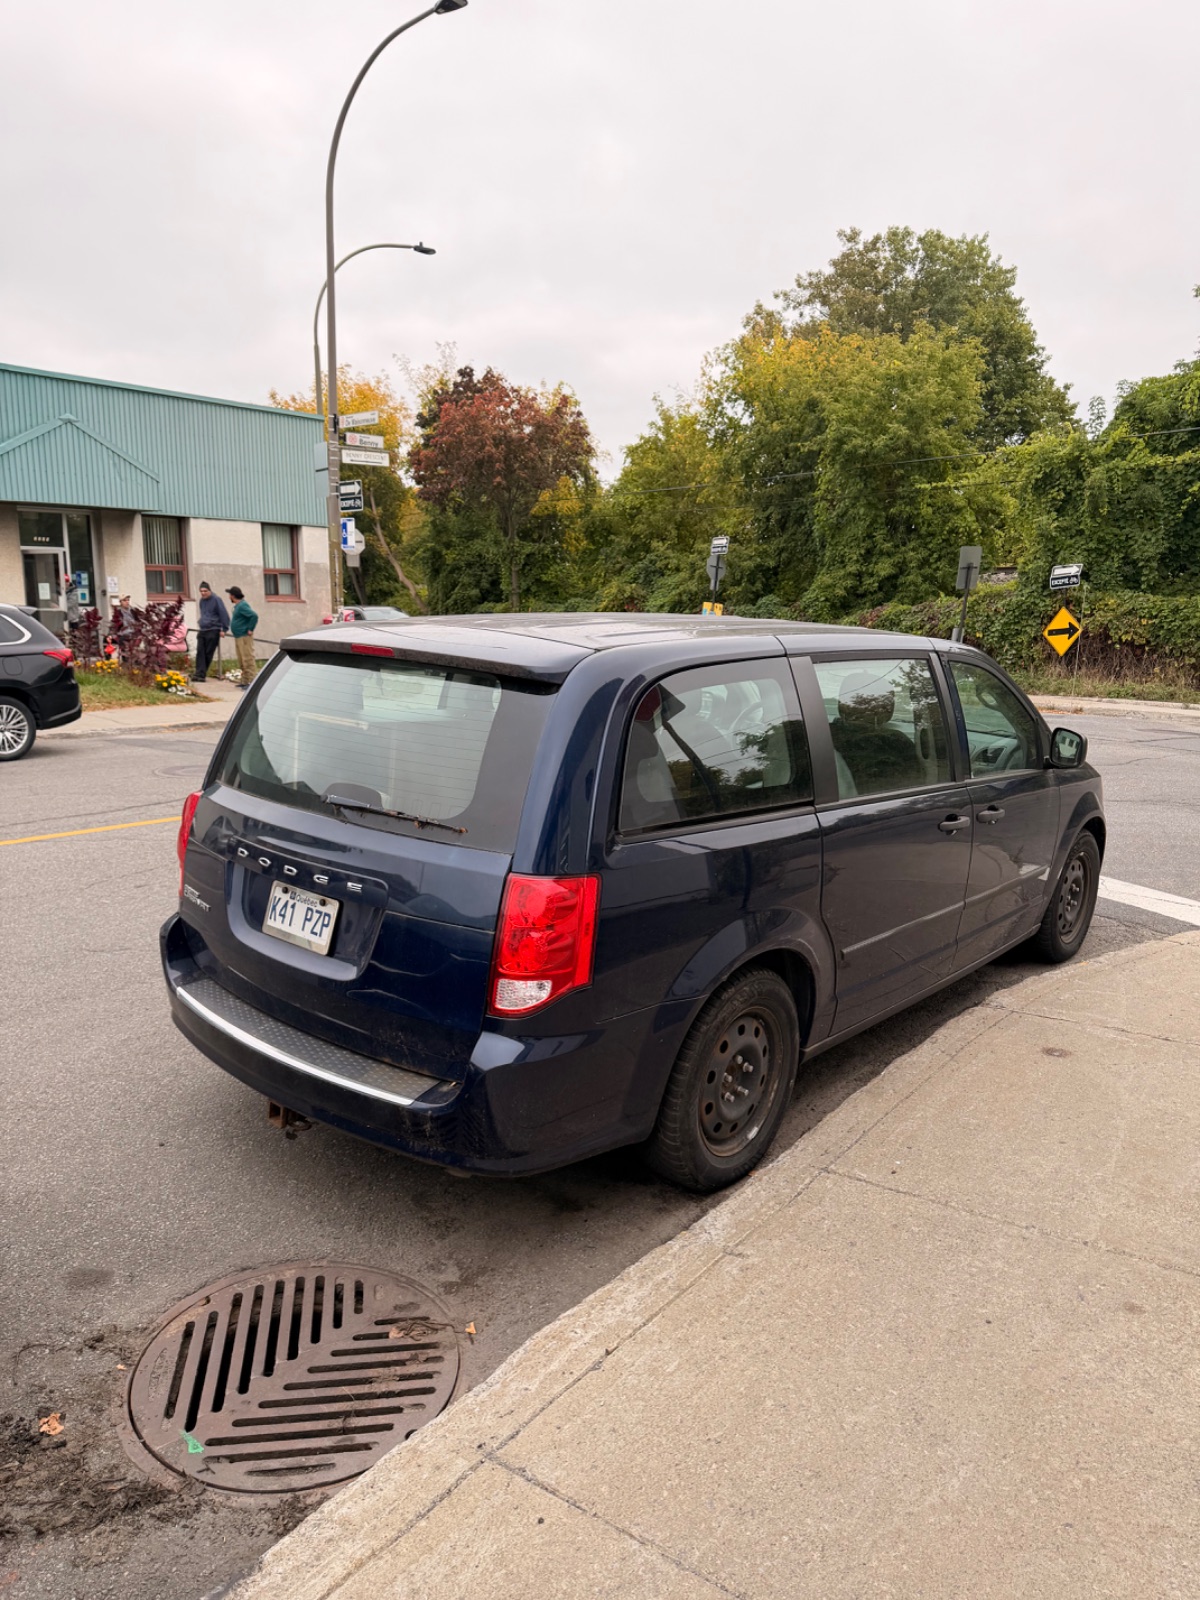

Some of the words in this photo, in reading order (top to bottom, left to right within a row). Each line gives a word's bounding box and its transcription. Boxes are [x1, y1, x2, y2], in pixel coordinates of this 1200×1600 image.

[359, 438, 379, 448] Benny
[237, 847, 363, 893] DODGE
[295, 894, 318, 908] Québec
[269, 896, 296, 927] K41
[301, 906, 332, 938] PZP
